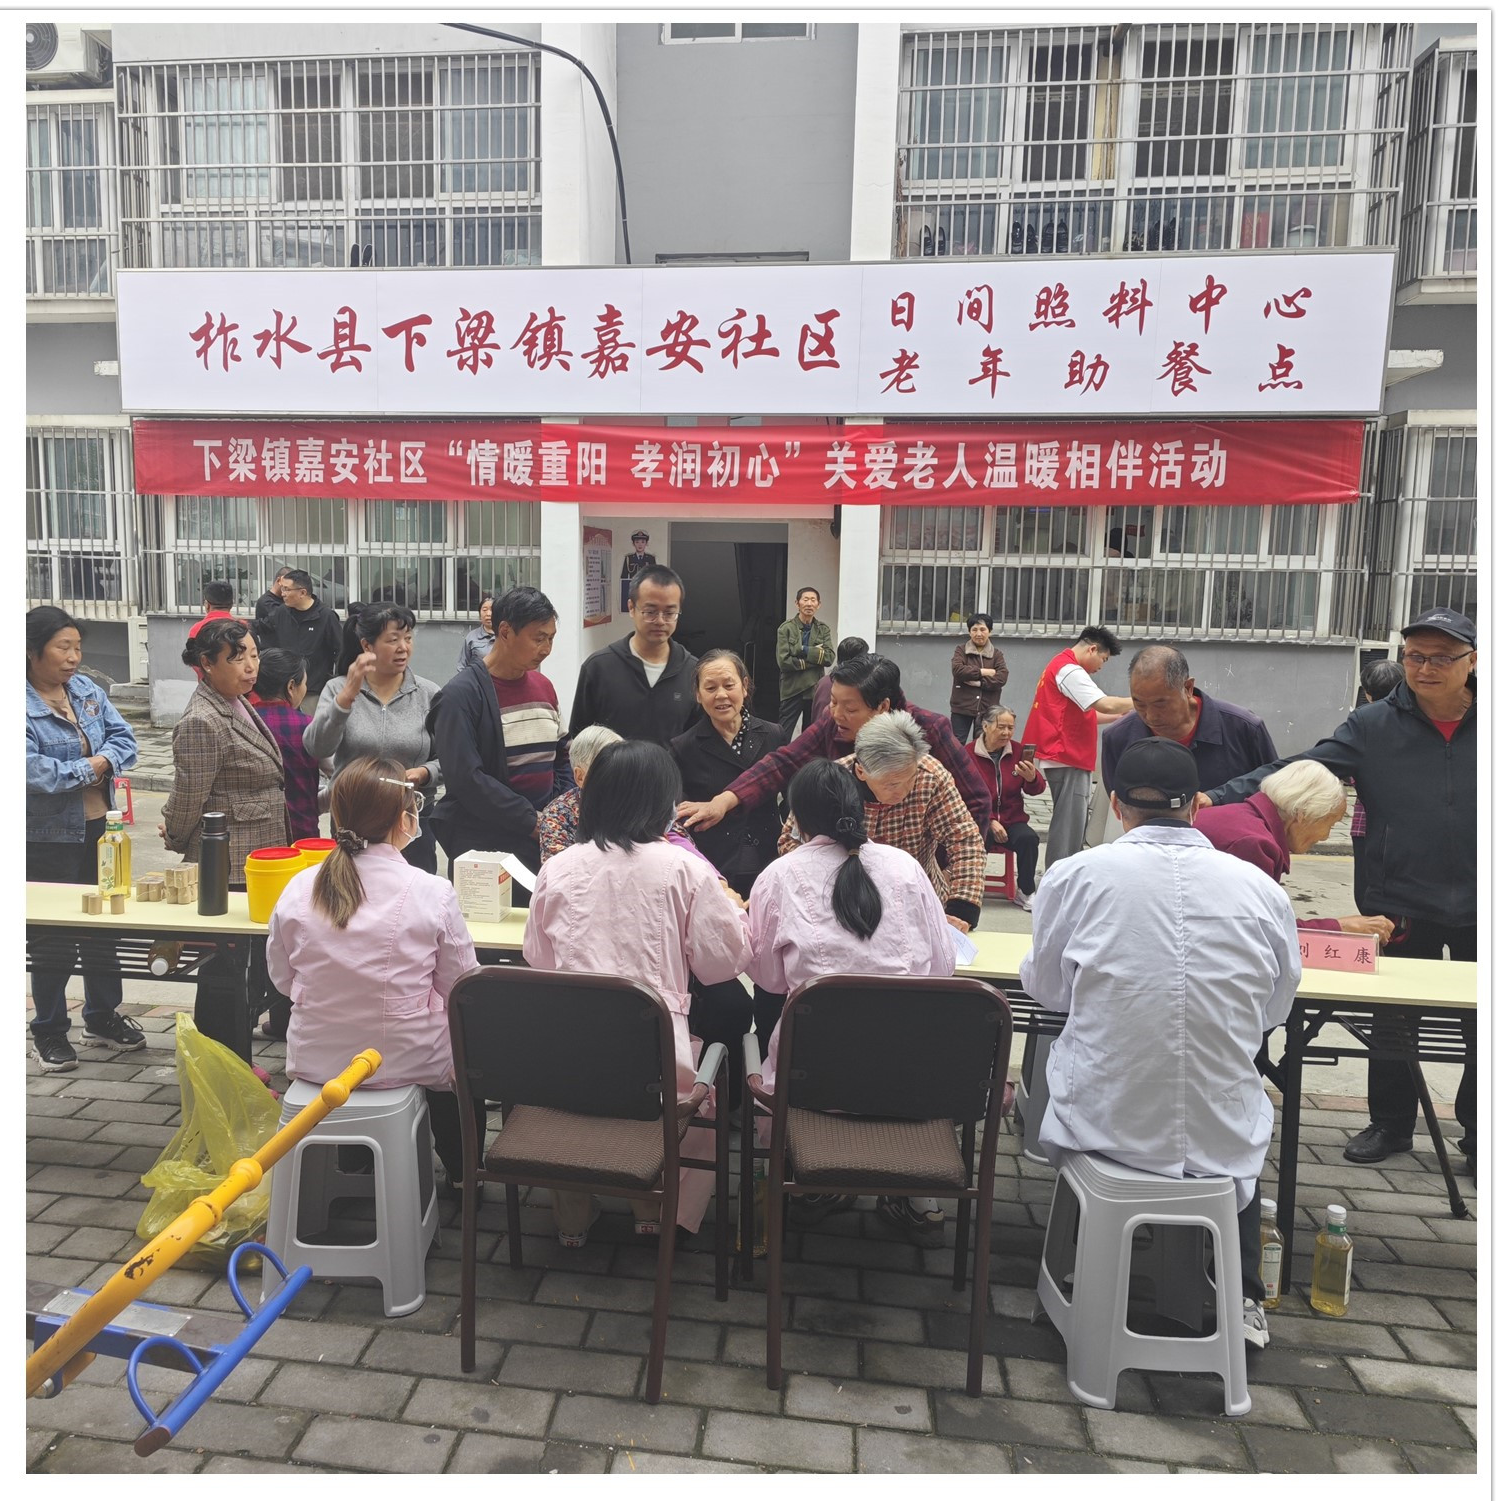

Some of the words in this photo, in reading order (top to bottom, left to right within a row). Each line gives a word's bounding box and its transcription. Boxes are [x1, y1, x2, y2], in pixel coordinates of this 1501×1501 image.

[890, 274, 1313, 336] 日间照料中心
[188, 303, 842, 380] 柞水县下梁镇嘉安社区
[878, 340, 1304, 399] 老年助餐点
[193, 437, 428, 485] 下梁镇嘉安社区
[824, 438, 1228, 490] 关爱老人温暖相伴活动
